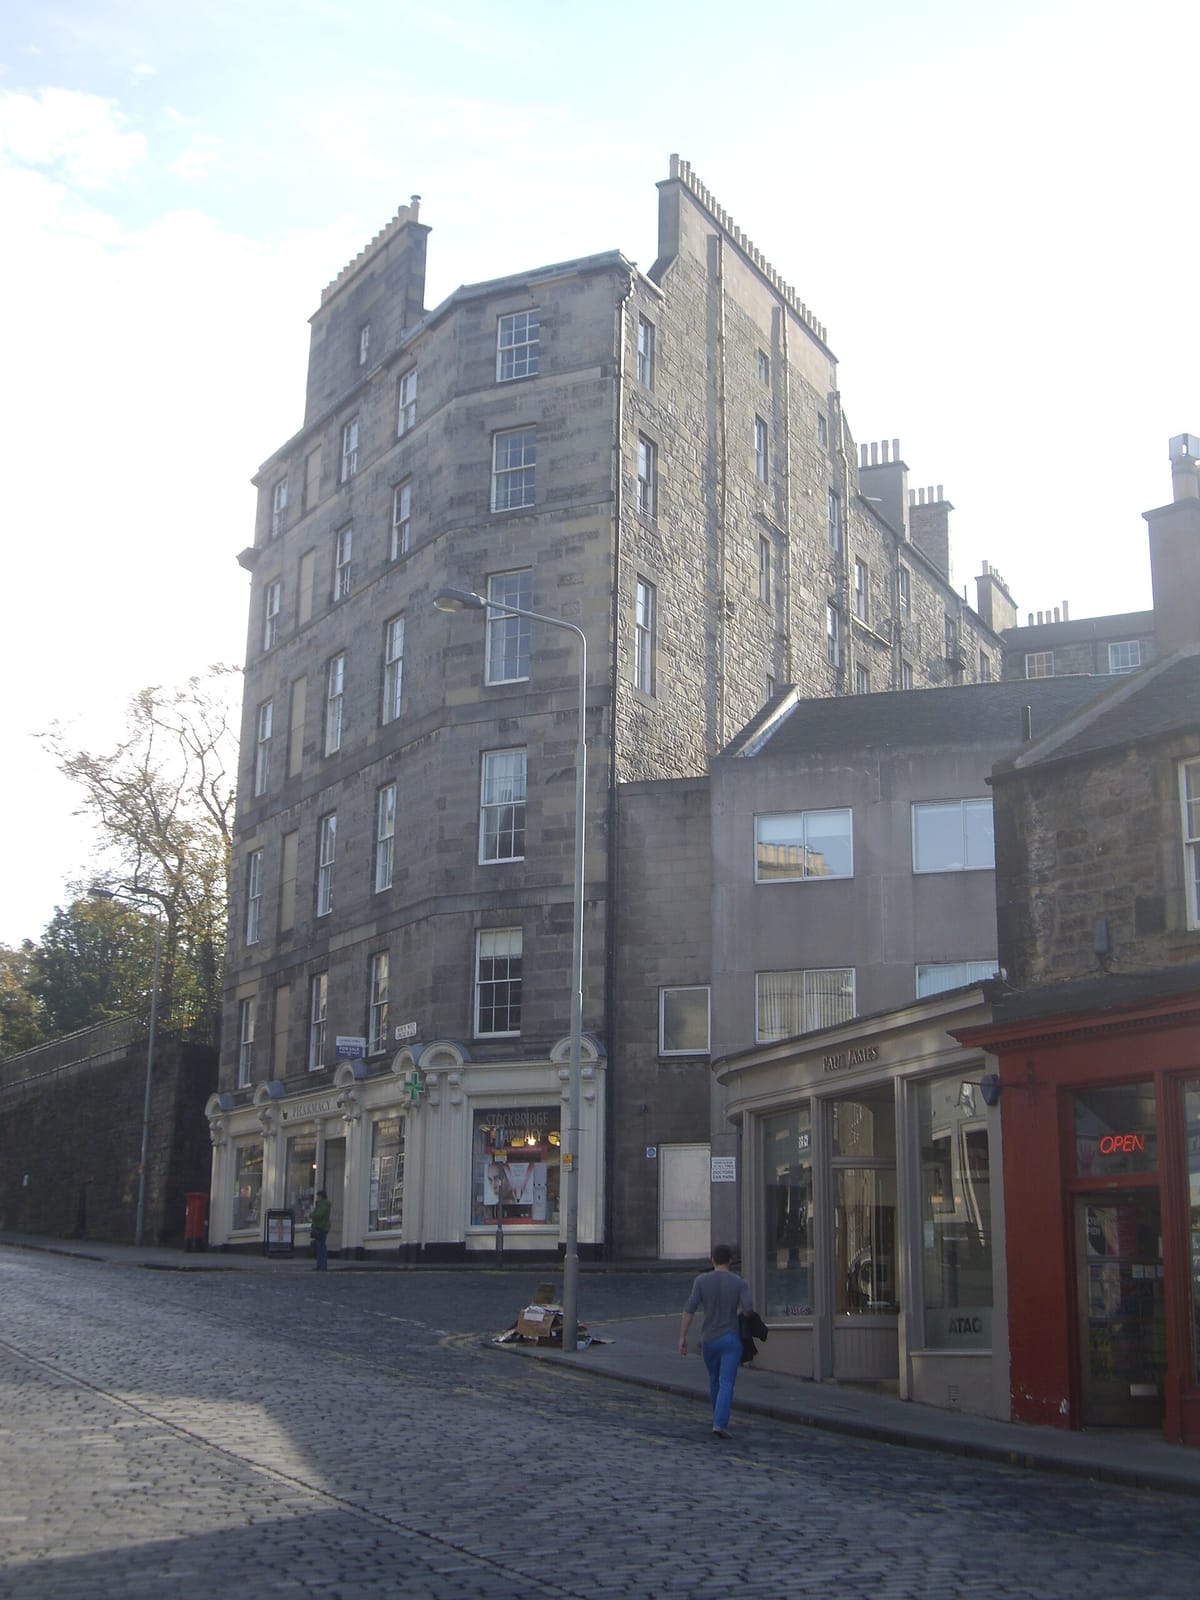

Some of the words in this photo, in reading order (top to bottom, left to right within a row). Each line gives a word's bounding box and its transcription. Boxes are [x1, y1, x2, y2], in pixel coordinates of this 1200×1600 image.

[847, 1046, 880, 1070] JAMES
[293, 1101, 330, 1117] PHARMACY
[486, 1111, 549, 1127] STOCKBRIDGE
[494, 1127, 543, 1143] ARMACY
[1100, 1134, 1146, 1154] OPEN
